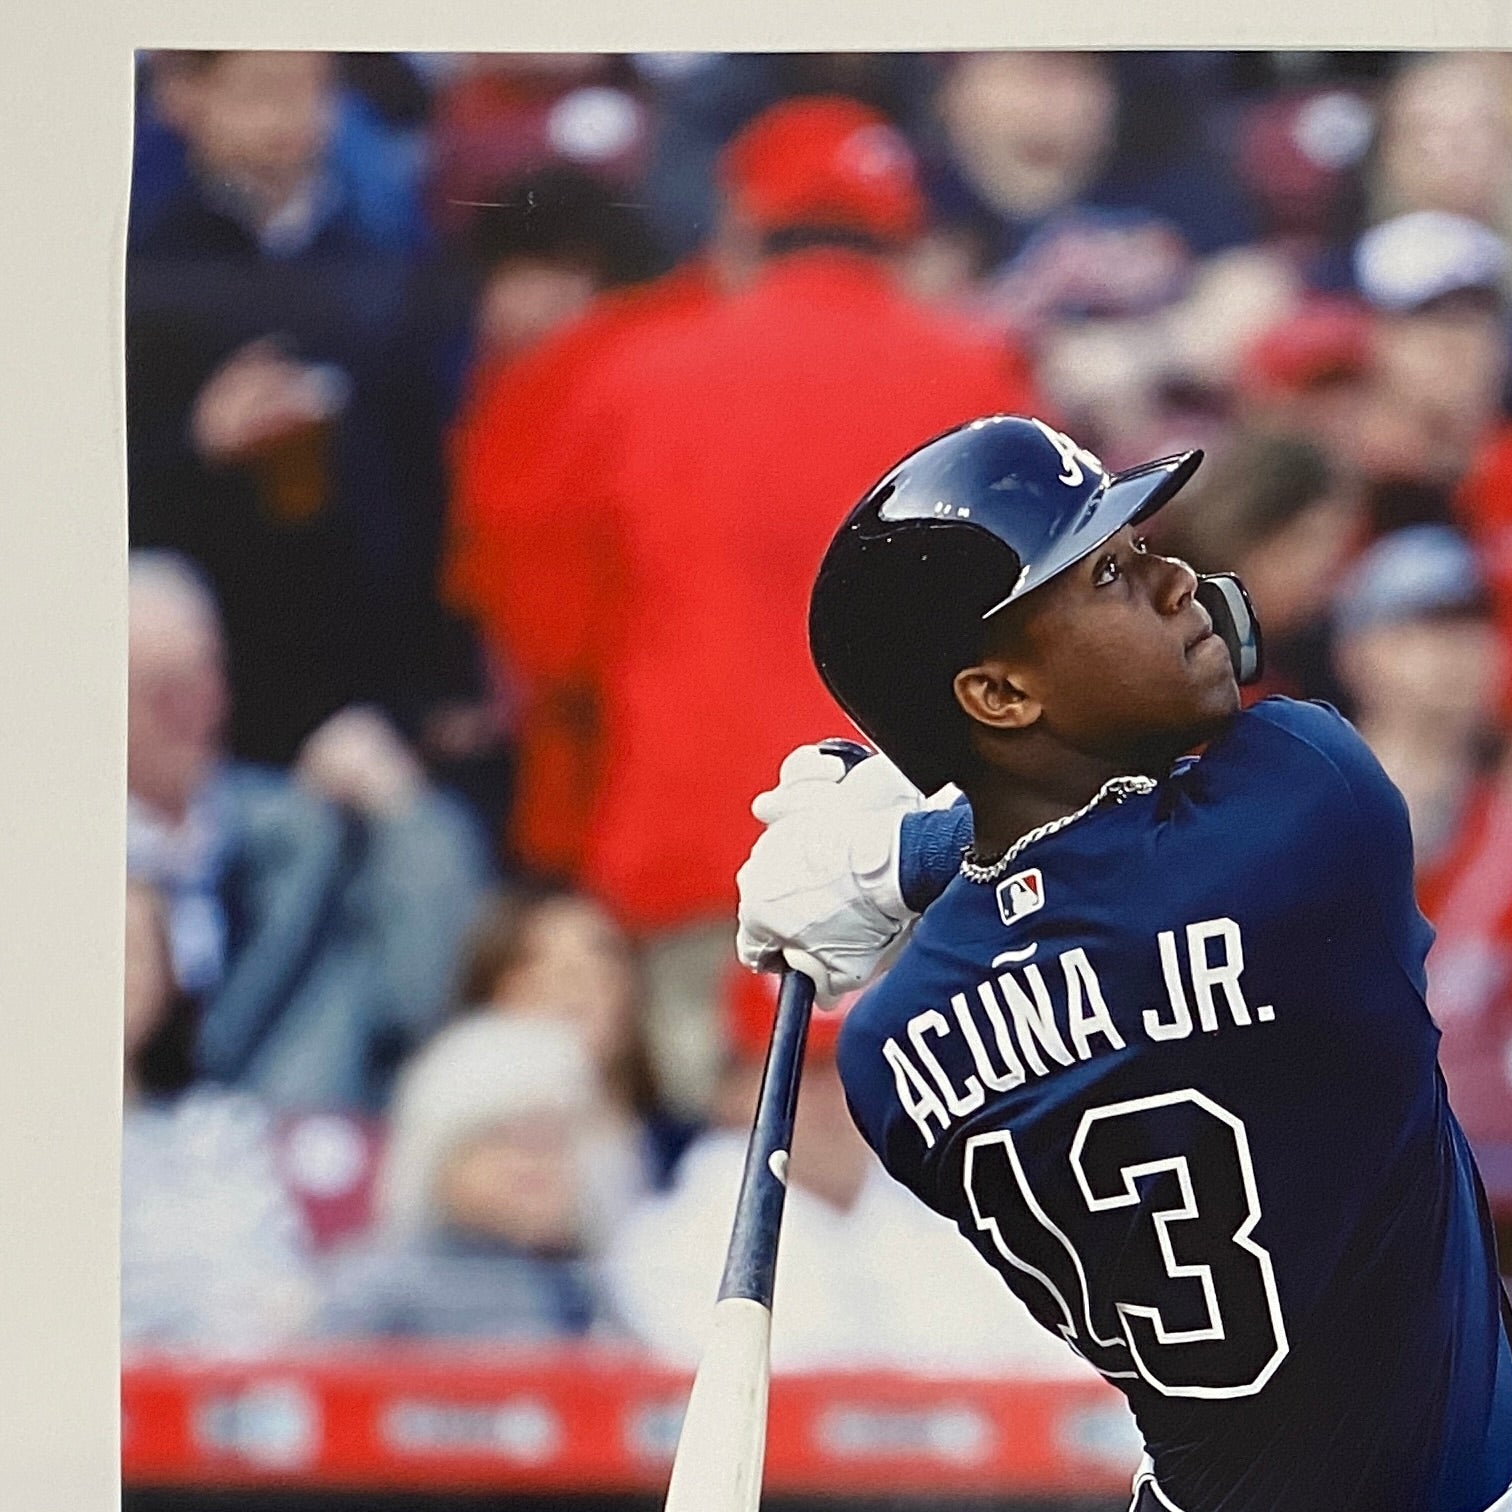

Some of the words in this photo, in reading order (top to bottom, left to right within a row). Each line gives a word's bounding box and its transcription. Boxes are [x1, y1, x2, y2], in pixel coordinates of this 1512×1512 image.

[883, 943, 1126, 1149] ACUÑA
[1142, 917, 1275, 1042] JR.
[963, 1088, 1290, 1399] 13
